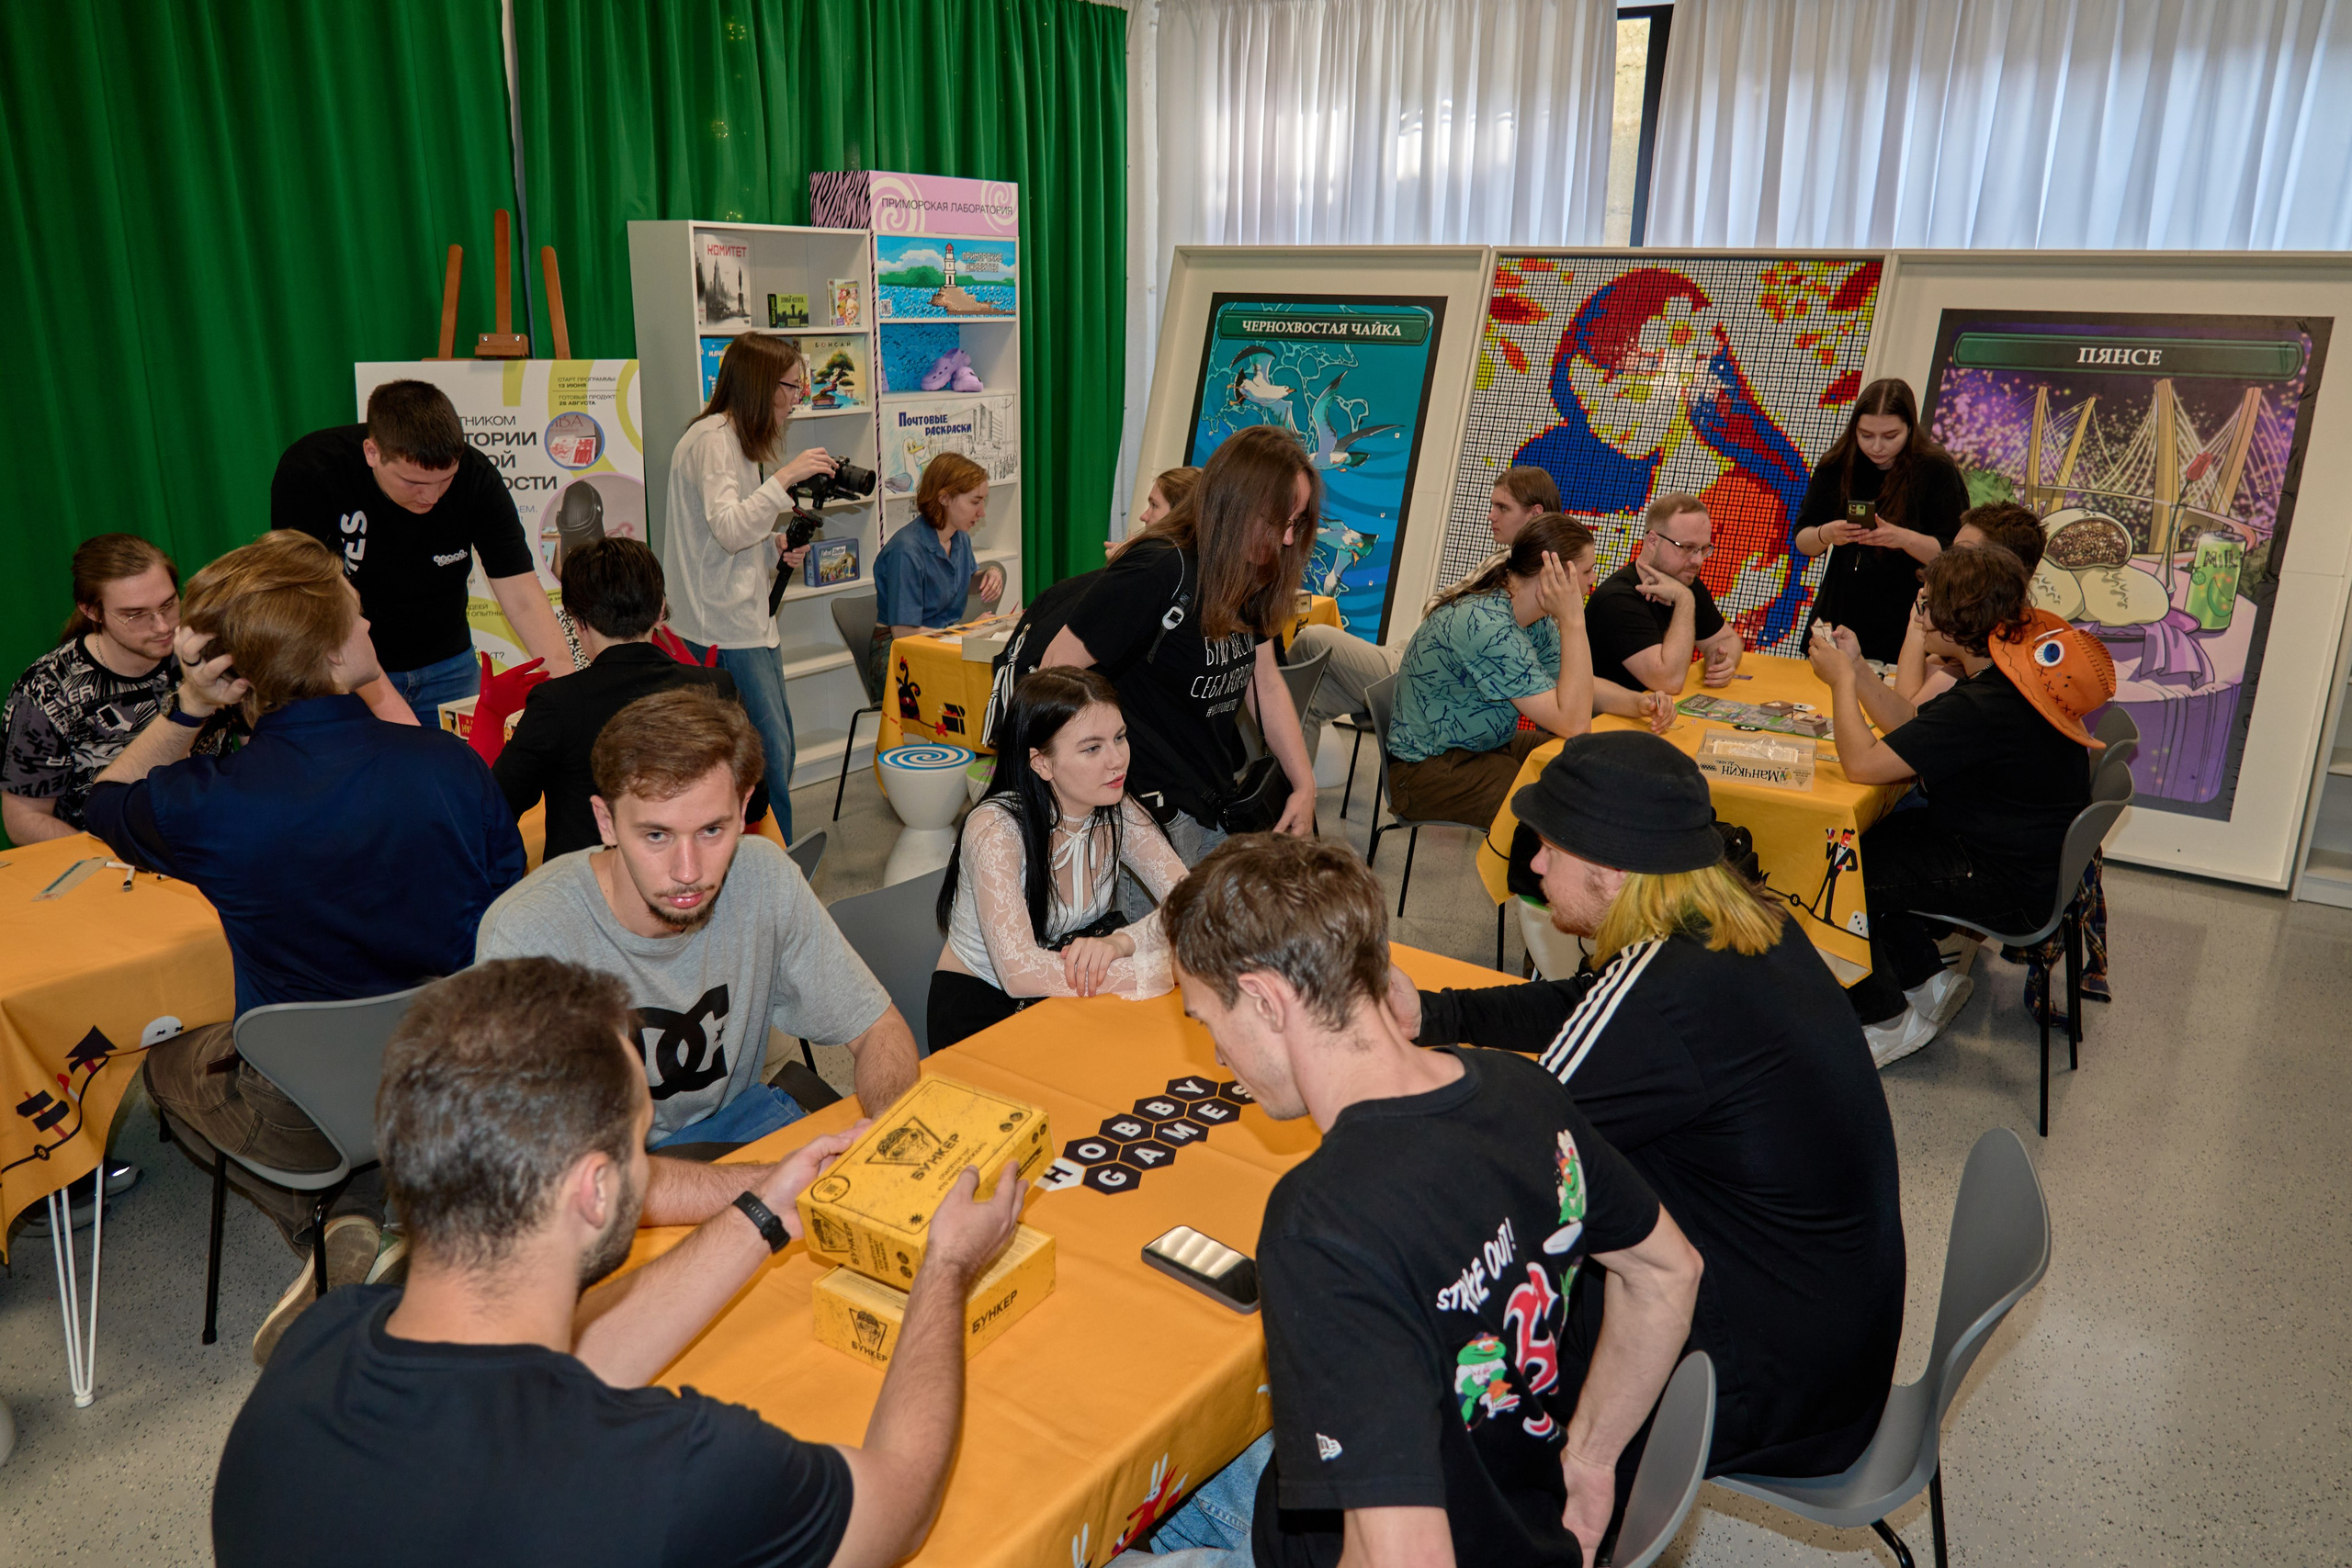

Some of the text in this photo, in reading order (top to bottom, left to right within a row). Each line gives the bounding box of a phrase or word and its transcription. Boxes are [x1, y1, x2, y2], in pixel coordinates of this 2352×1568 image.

[881, 197, 1012, 215] ПРИМОРСКАЯ ЛАБОРАТОРИЯ
[707, 244, 747, 257] КОМИТЕТ
[962, 252, 1003, 263] ПРИМОРСКИЕ
[1242, 321, 1402, 336] ЧЕРНОХВОСТАЯ ЧАЙКА
[2076, 347, 2163, 366] ПЯНСЕ
[459, 415, 516, 426] ТНИКОМ
[464, 432, 537, 446] ТОРИИ
[1043, 1078, 1205, 1185] HOBBY
[910, 1133, 959, 1181] БУНКЕР
[843, 1222, 860, 1266] БУНКЕР
[1436, 1217, 1517, 1314] STRKE OUT!
[971, 1290, 1018, 1335] БУНКЕР
[852, 1340, 888, 1363] БУНКЕР
